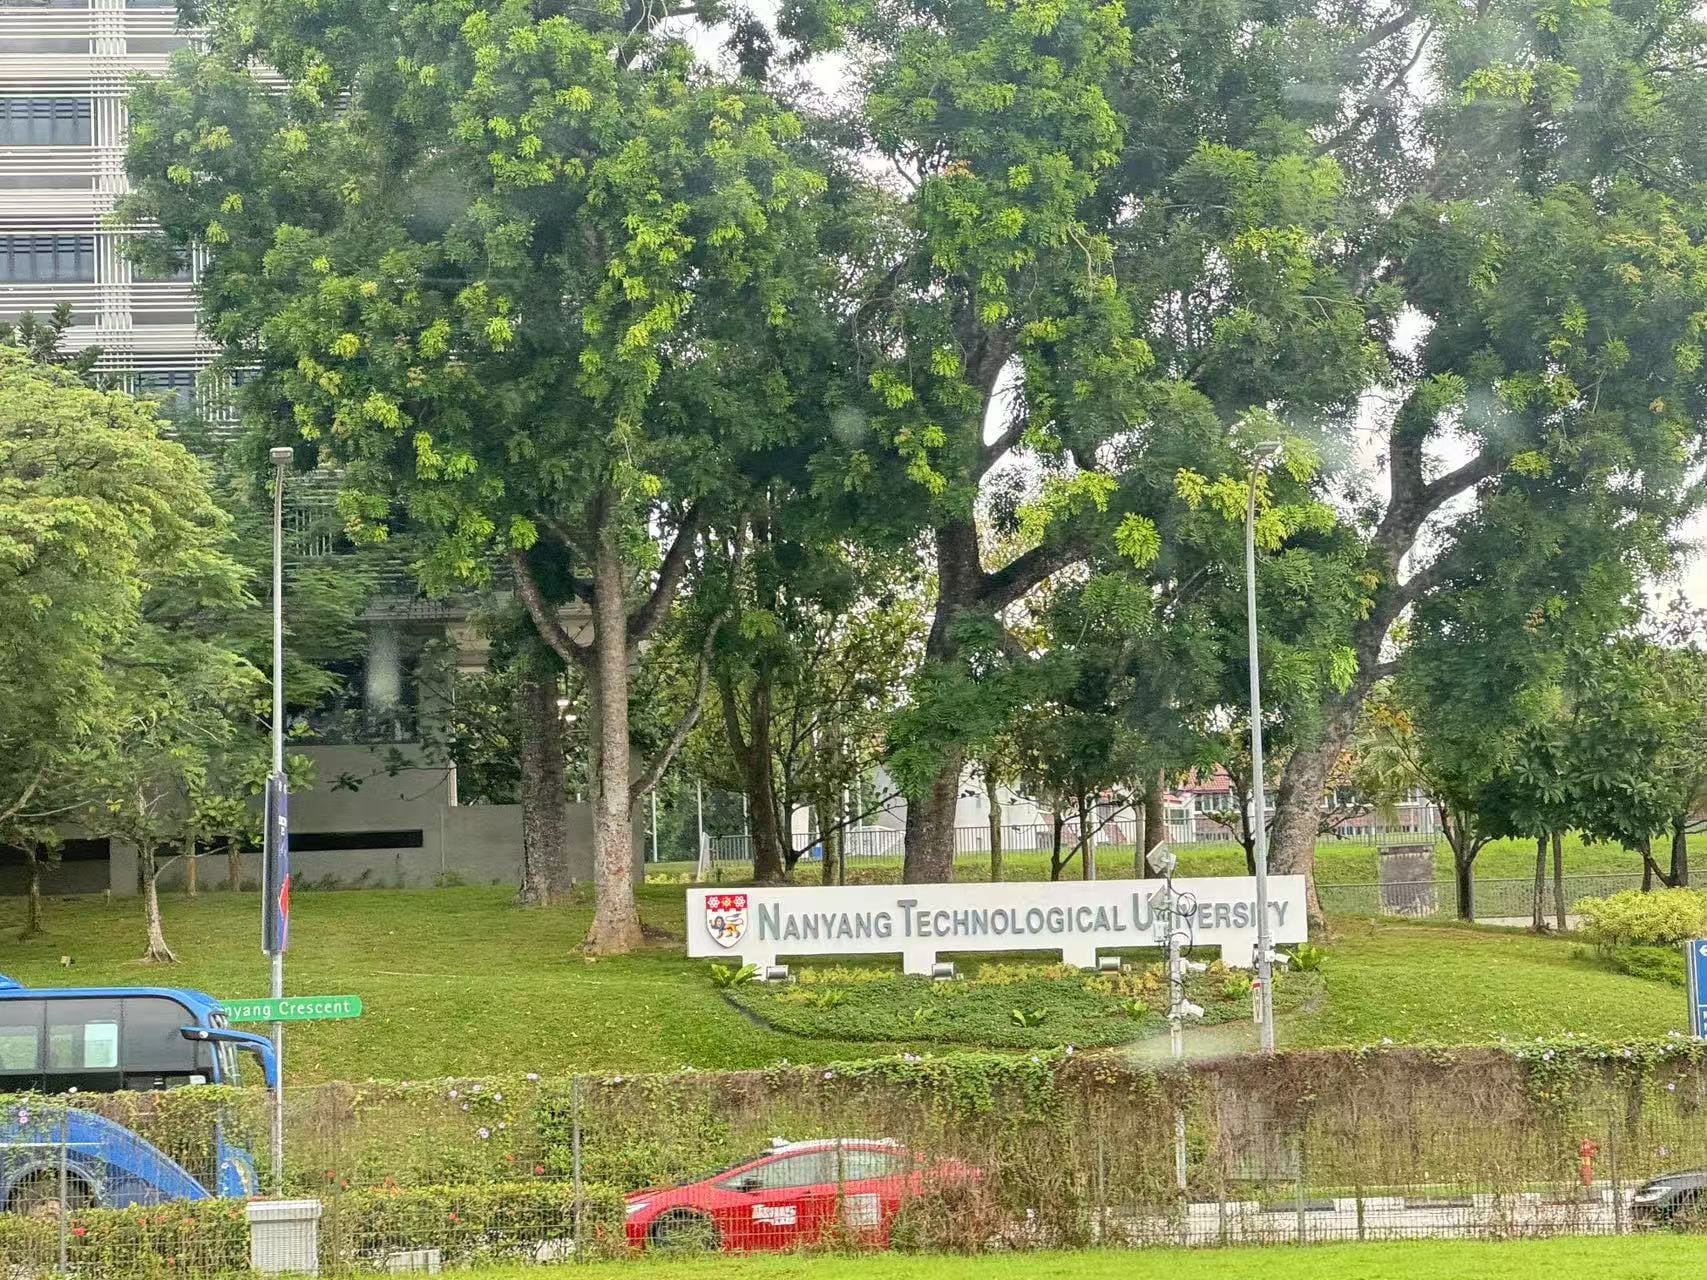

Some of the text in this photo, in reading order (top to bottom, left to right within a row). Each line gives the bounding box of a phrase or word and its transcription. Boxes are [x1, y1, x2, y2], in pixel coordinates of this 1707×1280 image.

[758, 892, 1289, 941] NANYANG TECHNOLOGICAL UIVERSIY
[224, 1001, 351, 1019] nyang Crescent
